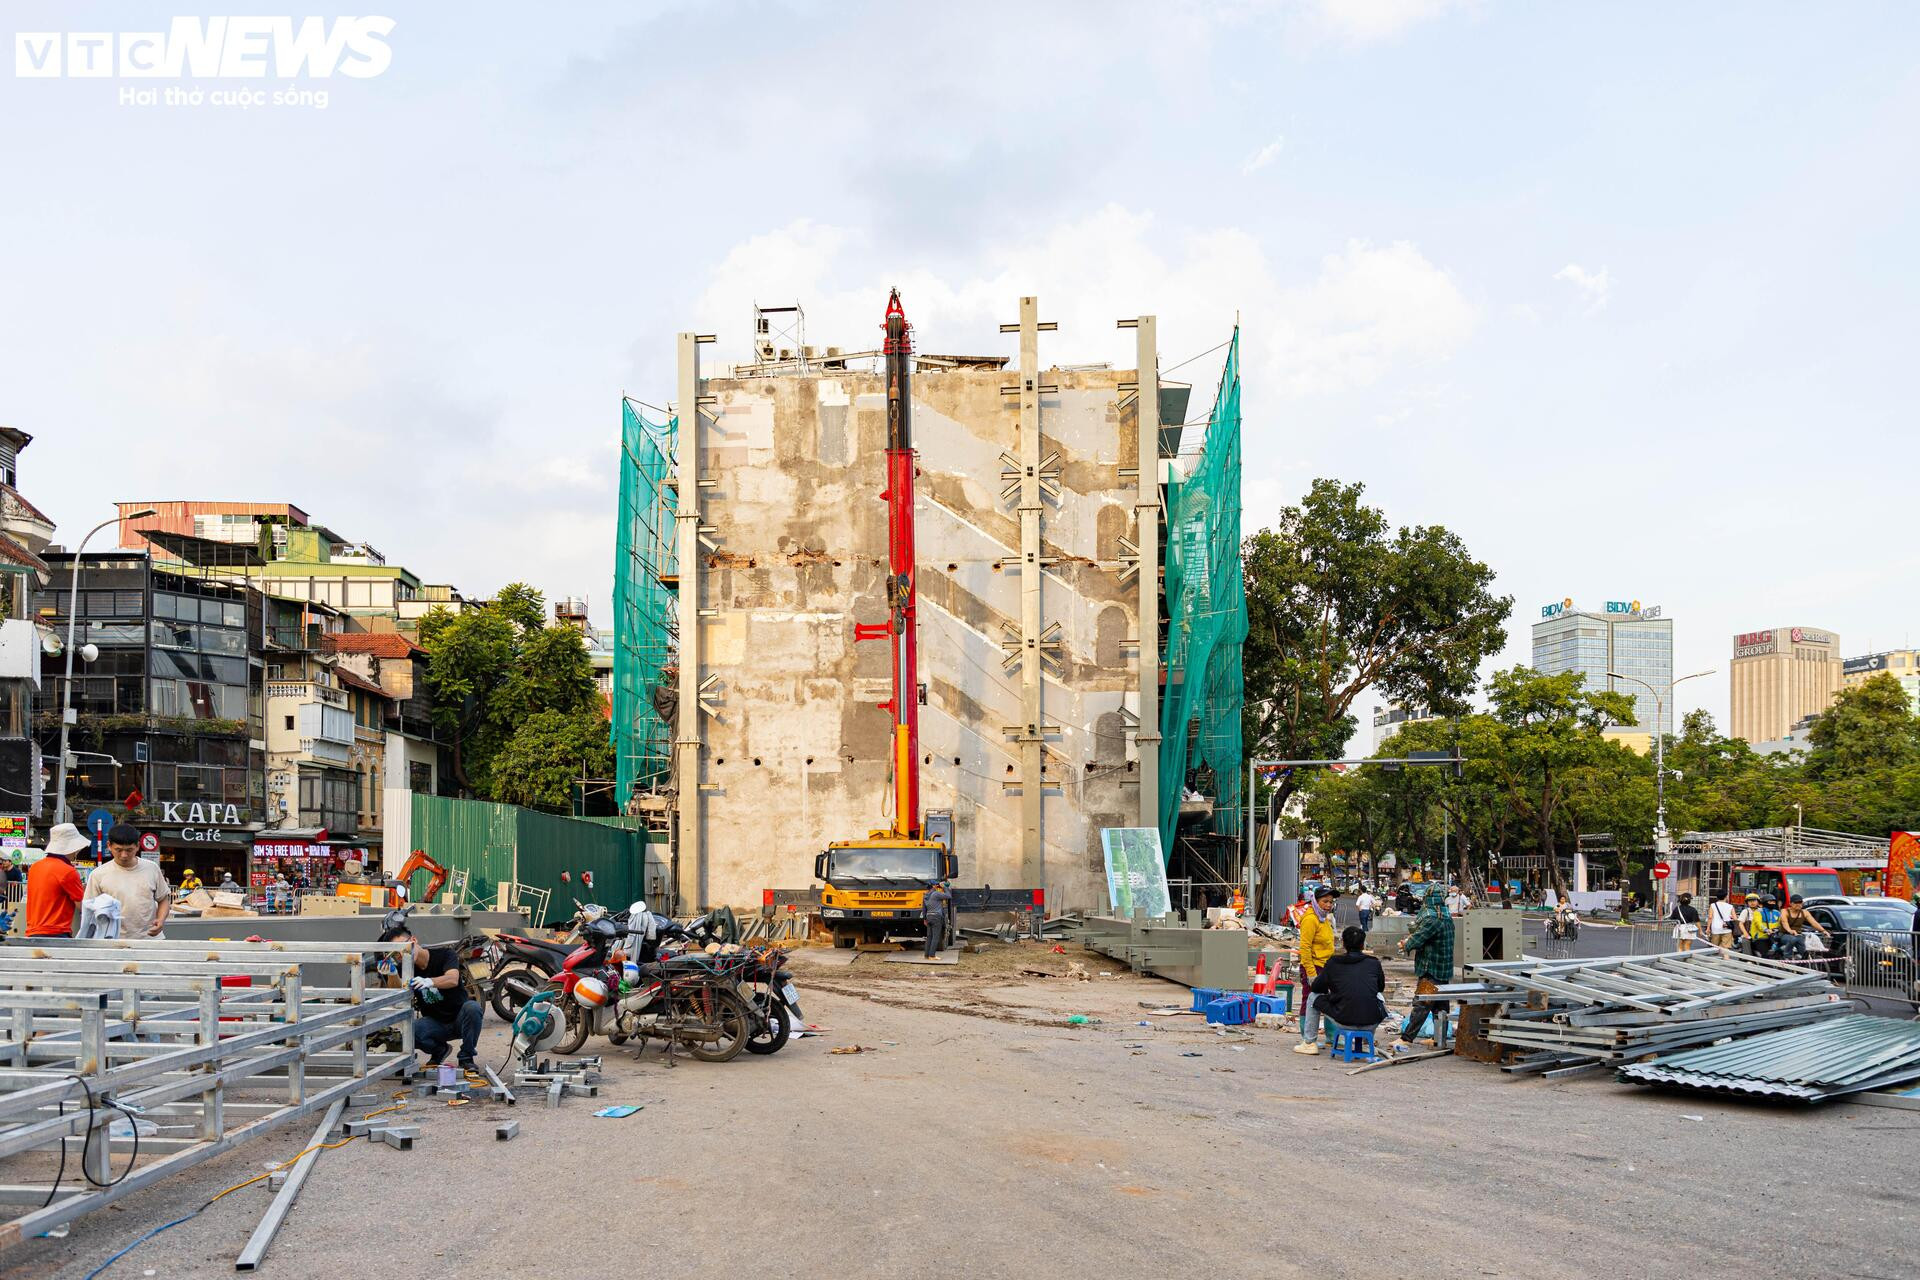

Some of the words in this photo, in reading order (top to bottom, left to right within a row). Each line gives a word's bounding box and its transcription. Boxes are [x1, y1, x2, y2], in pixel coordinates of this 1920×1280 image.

[1542, 602, 1564, 617] BIDV
[1606, 601, 1632, 613] BIDV
[1736, 644, 1773, 657] GROUP
[161, 801, 242, 825] KAFA
[181, 827, 222, 842] Café
[253, 844, 265, 857] SIM
[274, 844, 289, 857] FREE
[289, 844, 304, 857] DATA
[868, 891, 897, 899] SANY
